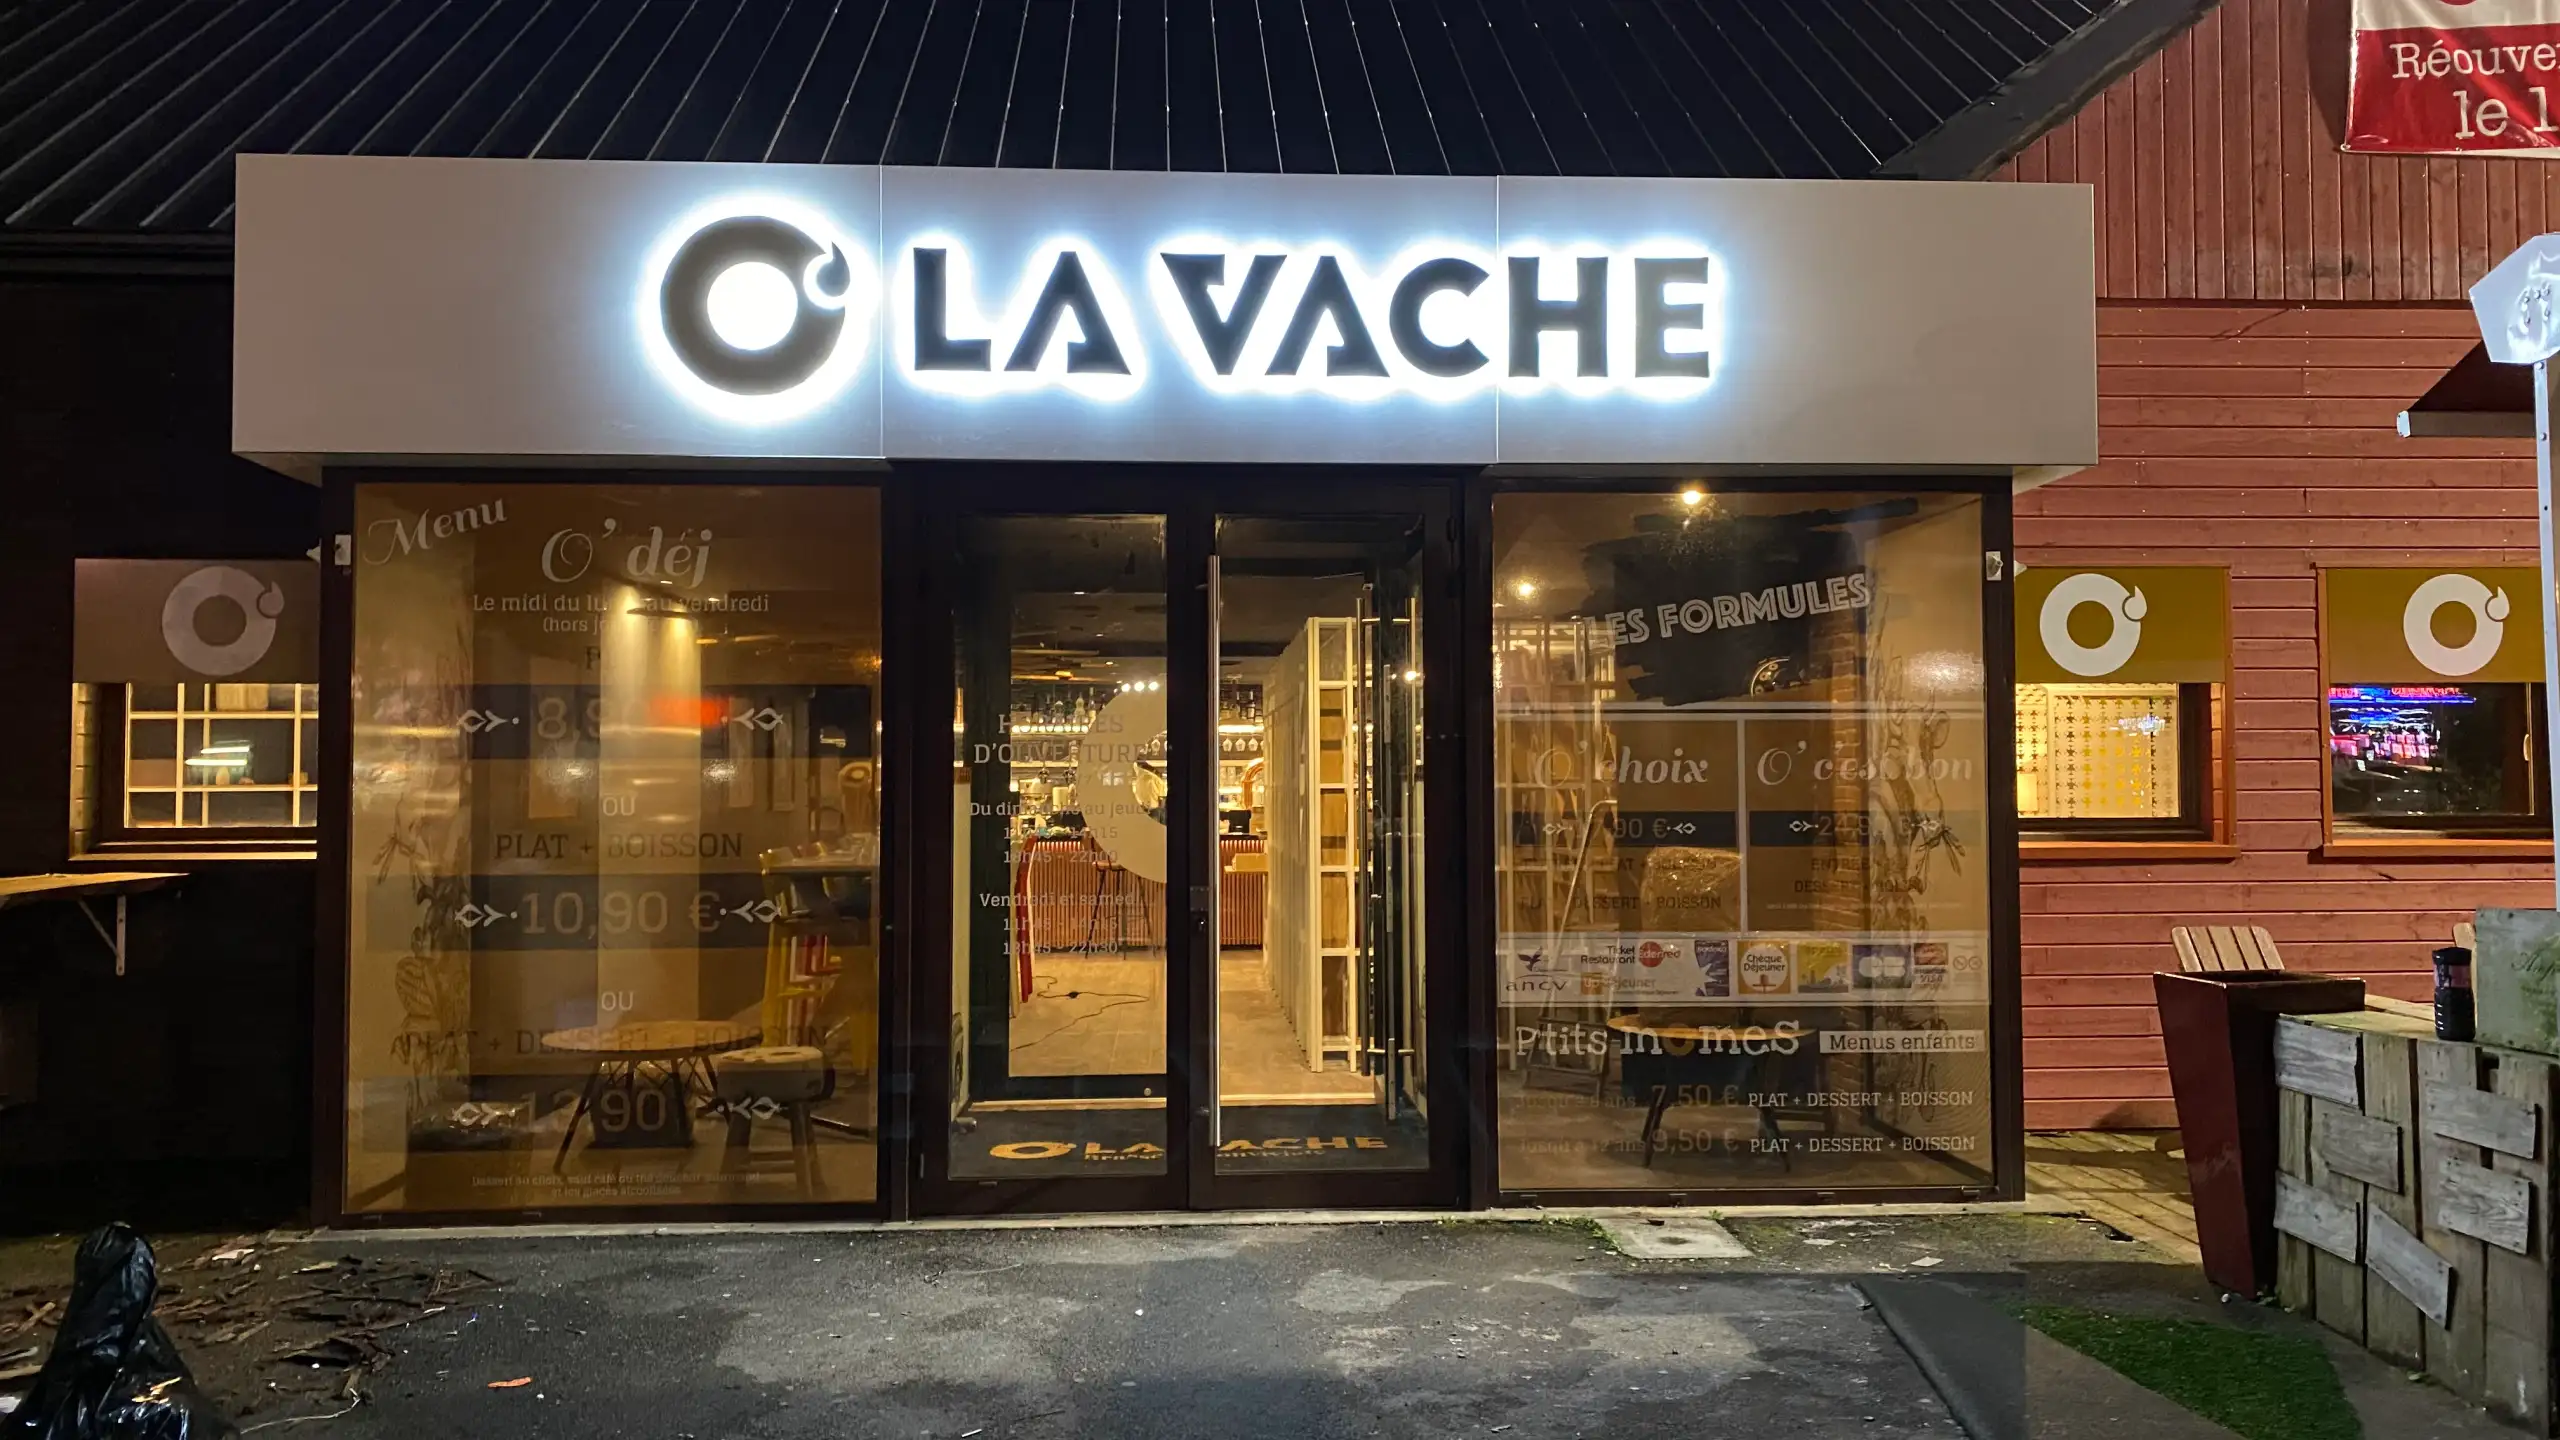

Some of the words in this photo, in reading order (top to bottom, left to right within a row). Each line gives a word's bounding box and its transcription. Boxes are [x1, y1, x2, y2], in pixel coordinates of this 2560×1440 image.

[2389, 39, 2560, 80] Réouve
[2453, 90, 2509, 140] le
[913, 247, 1132, 375] LA
[1159, 252, 1711, 378] VACHE
[362, 498, 507, 566] Menu
[473, 594, 495, 612] Le
[501, 594, 549, 612] midi
[554, 594, 580, 612] du
[645, 598, 672, 612] au
[677, 594, 769, 613] vendredi
[1656, 572, 1871, 639] FORMULES
[543, 617, 588, 633] (hors
[602, 796, 636, 817] OU
[493, 833, 568, 858] PLAT
[607, 832, 743, 858] BOISSON
[520, 891, 669, 940] 10,90
[688, 891, 722, 934] €
[1505, 980, 1568, 993] ancv
[601, 991, 635, 1012] OU
[1829, 1034, 1896, 1051] Menus
[1901, 1033, 1975, 1050] enfants
[1651, 1084, 1712, 1107] 750
[1748, 1092, 1788, 1107] PLAT
[1807, 1092, 1881, 1107] DESSERT
[1900, 1091, 1973, 1106] BOISSON
[1085, 1141, 1166, 1154] LA
[1218, 1136, 1388, 1151] ACHE
[1750, 1138, 1790, 1153] PLAT
[1809, 1137, 1884, 1152] DESSERT
[1903, 1136, 1975, 1151] BOISSON
